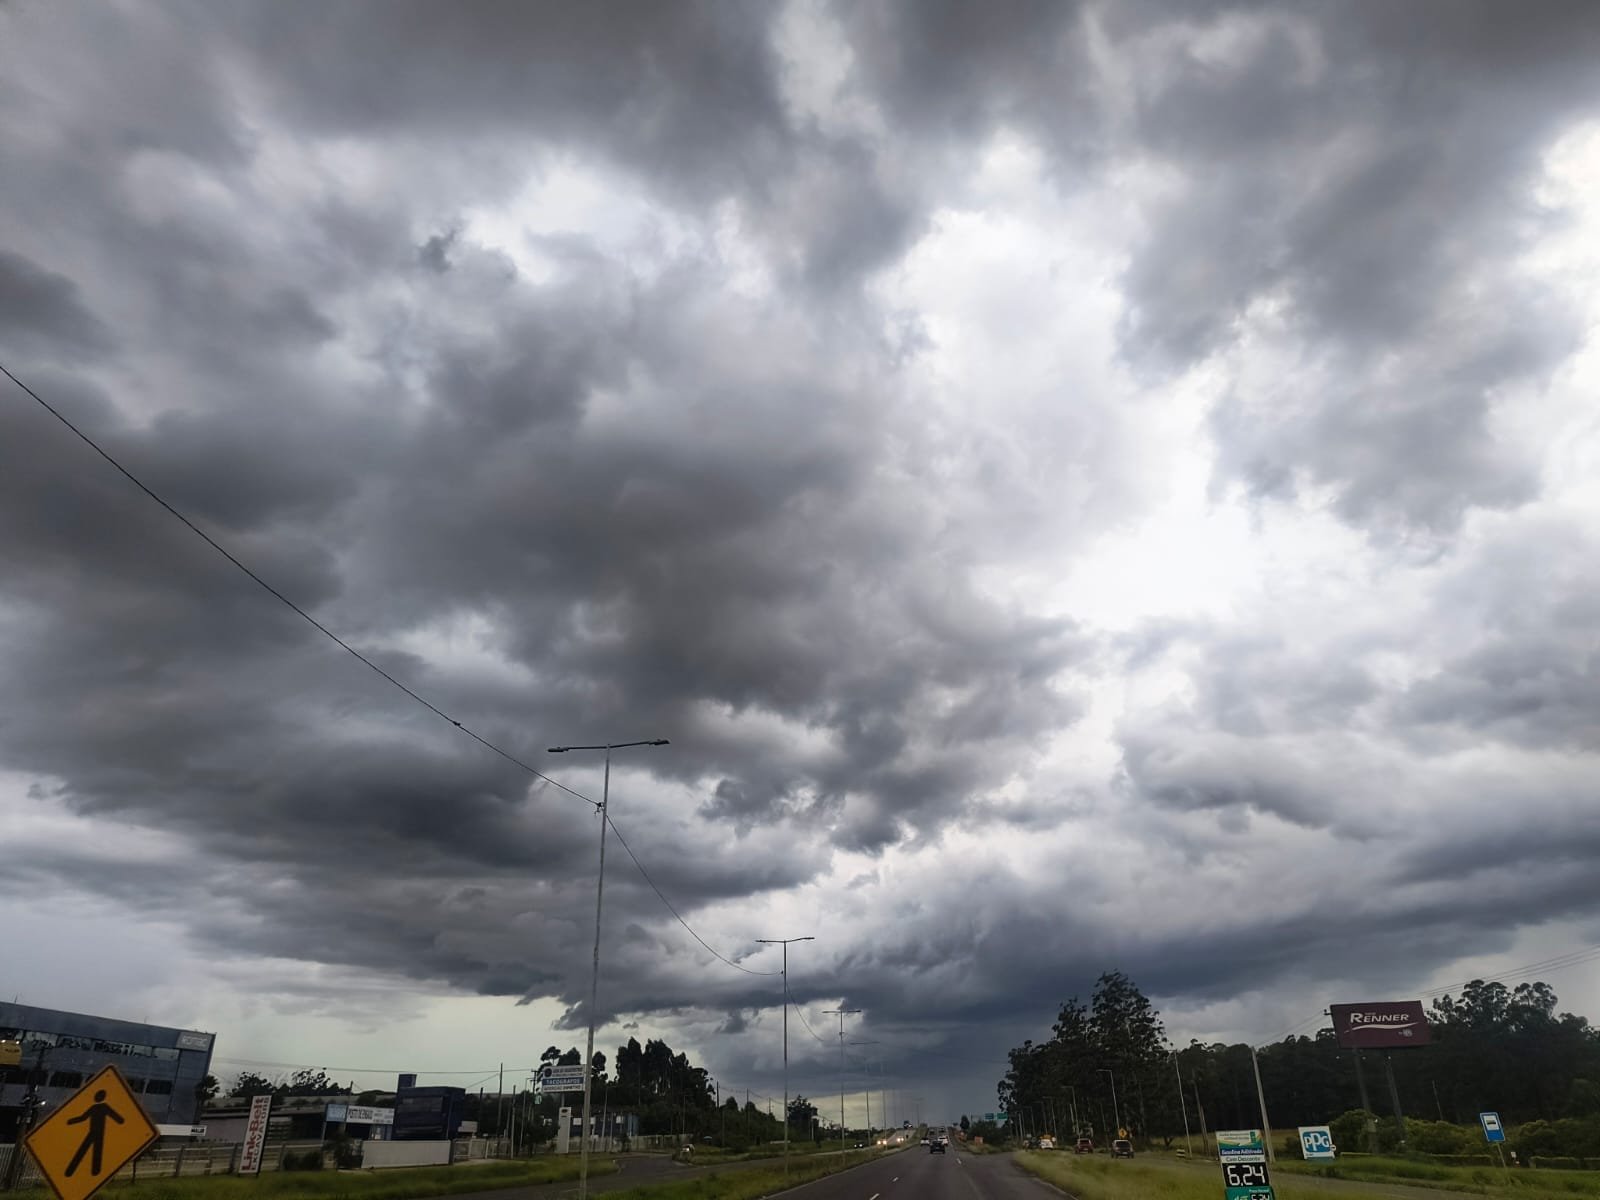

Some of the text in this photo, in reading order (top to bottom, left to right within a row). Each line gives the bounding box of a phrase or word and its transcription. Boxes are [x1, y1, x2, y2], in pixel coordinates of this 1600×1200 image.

[1350, 1012, 1409, 1024] RENNER
[241, 1098, 264, 1170] Link-Belt
[1303, 1132, 1330, 1151] PPG
